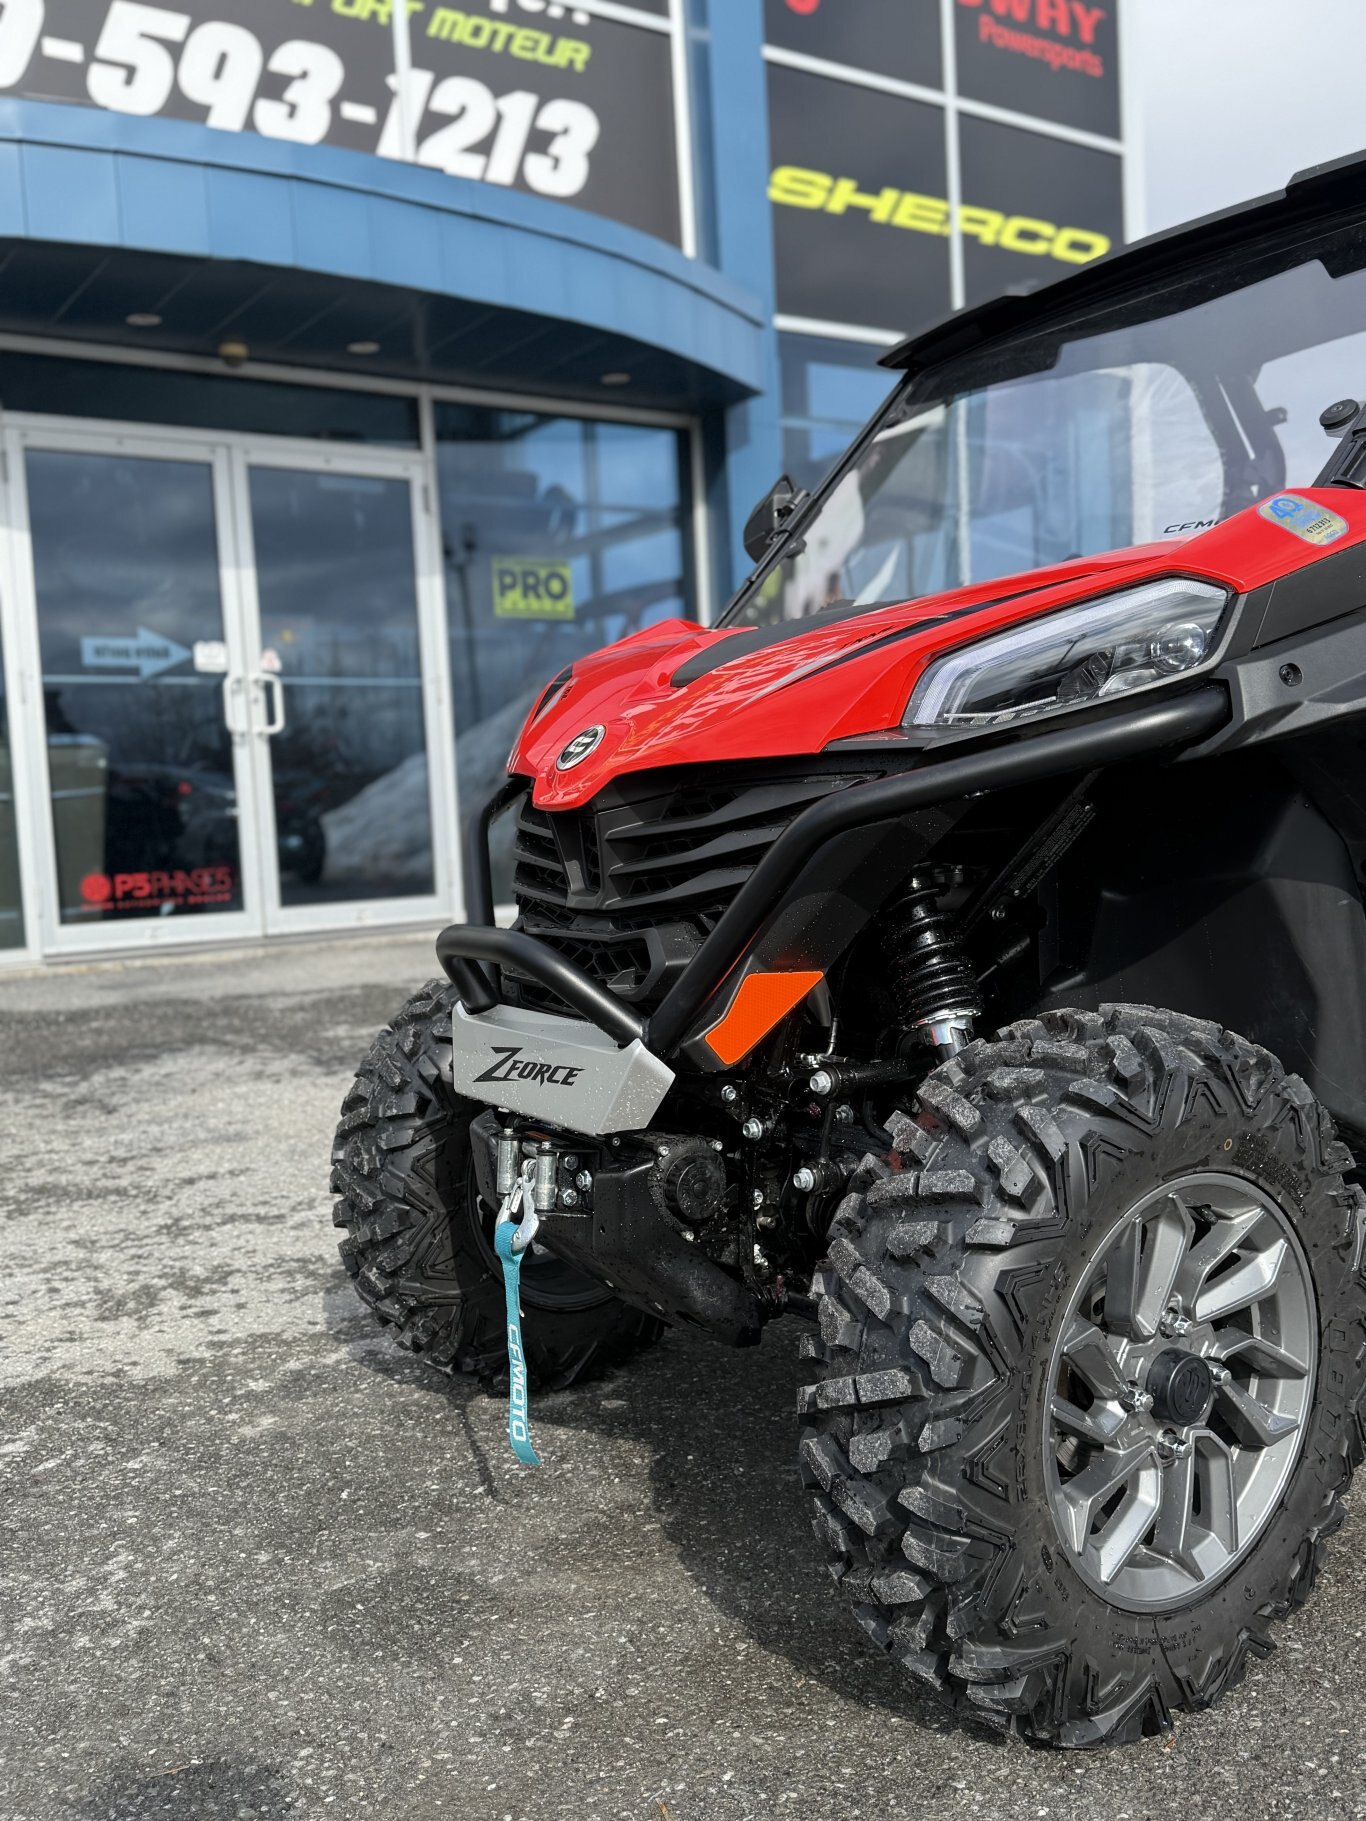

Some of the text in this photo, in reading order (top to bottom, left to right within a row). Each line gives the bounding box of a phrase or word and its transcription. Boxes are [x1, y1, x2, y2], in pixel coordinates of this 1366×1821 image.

[426, 7, 591, 72] MOTEUR
[957, 0, 1107, 44] WAY
[978, 13, 1104, 78] Powersports
[767, 166, 1111, 264] SHERCO
[498, 568, 568, 600] PRO
[508, 1323, 526, 1442] CFMOTO
